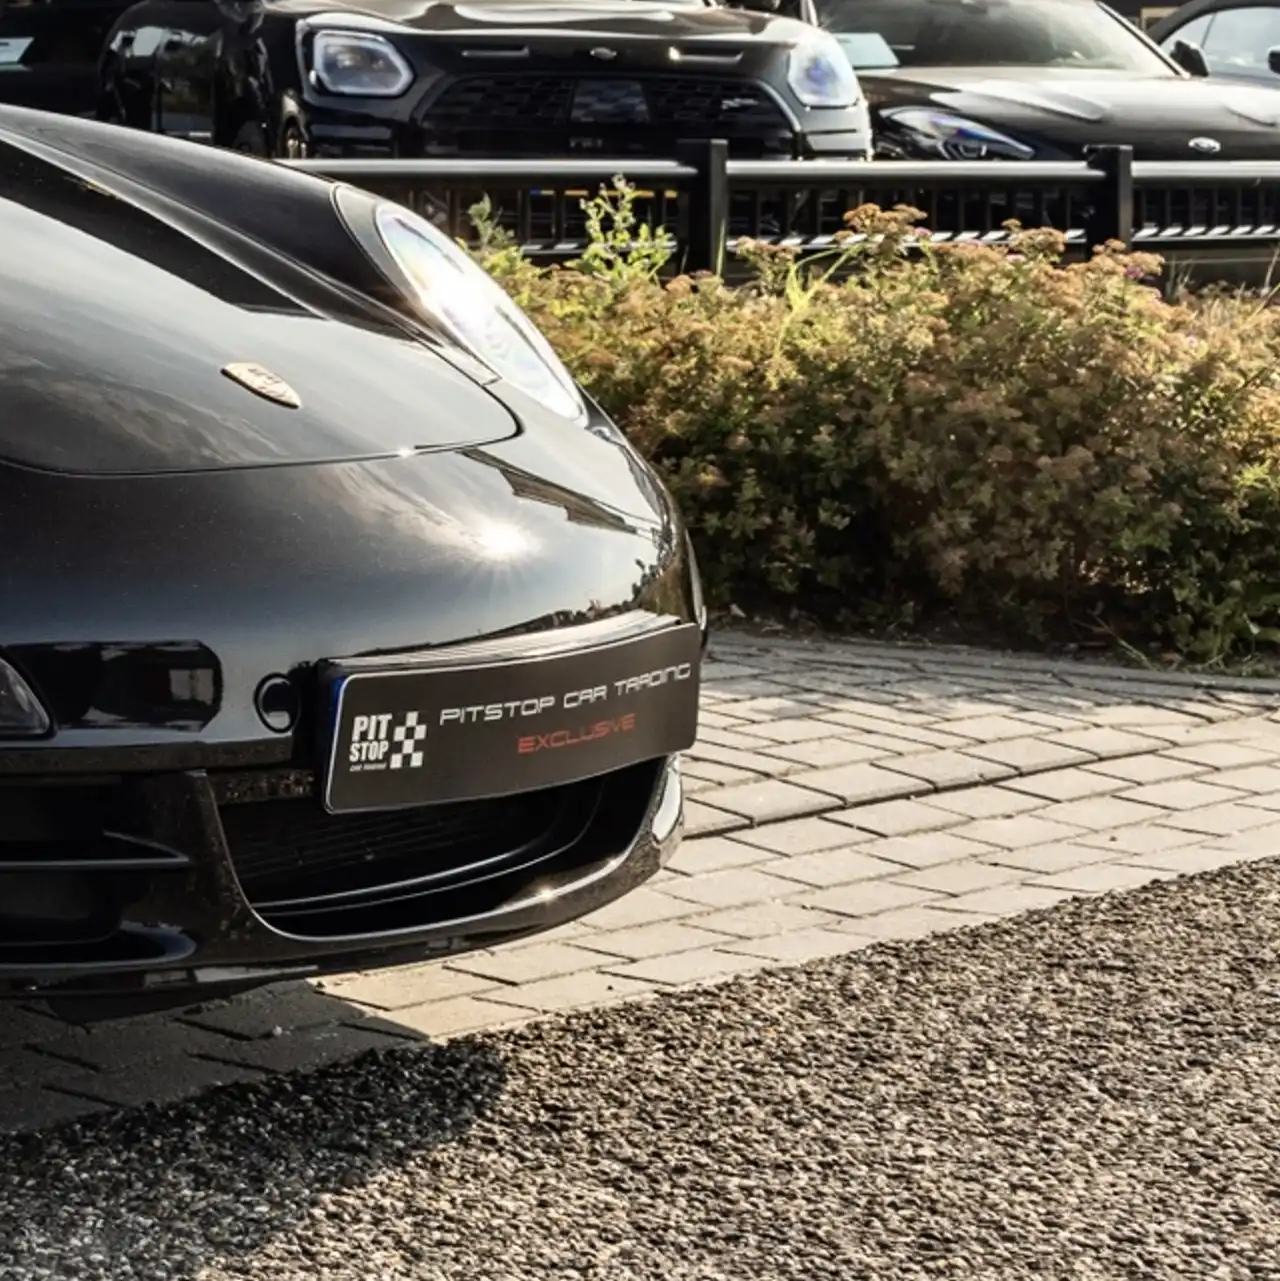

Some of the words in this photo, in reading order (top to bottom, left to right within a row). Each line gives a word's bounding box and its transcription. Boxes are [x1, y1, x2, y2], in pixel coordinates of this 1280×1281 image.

[440, 695, 556, 725] PITSTOP
[563, 685, 608, 710] CAR
[614, 663, 691, 697] TRADING
[351, 713, 393, 742] PIT
[517, 713, 636, 754] EXCLUSIVE
[348, 740, 390, 763] STOP
